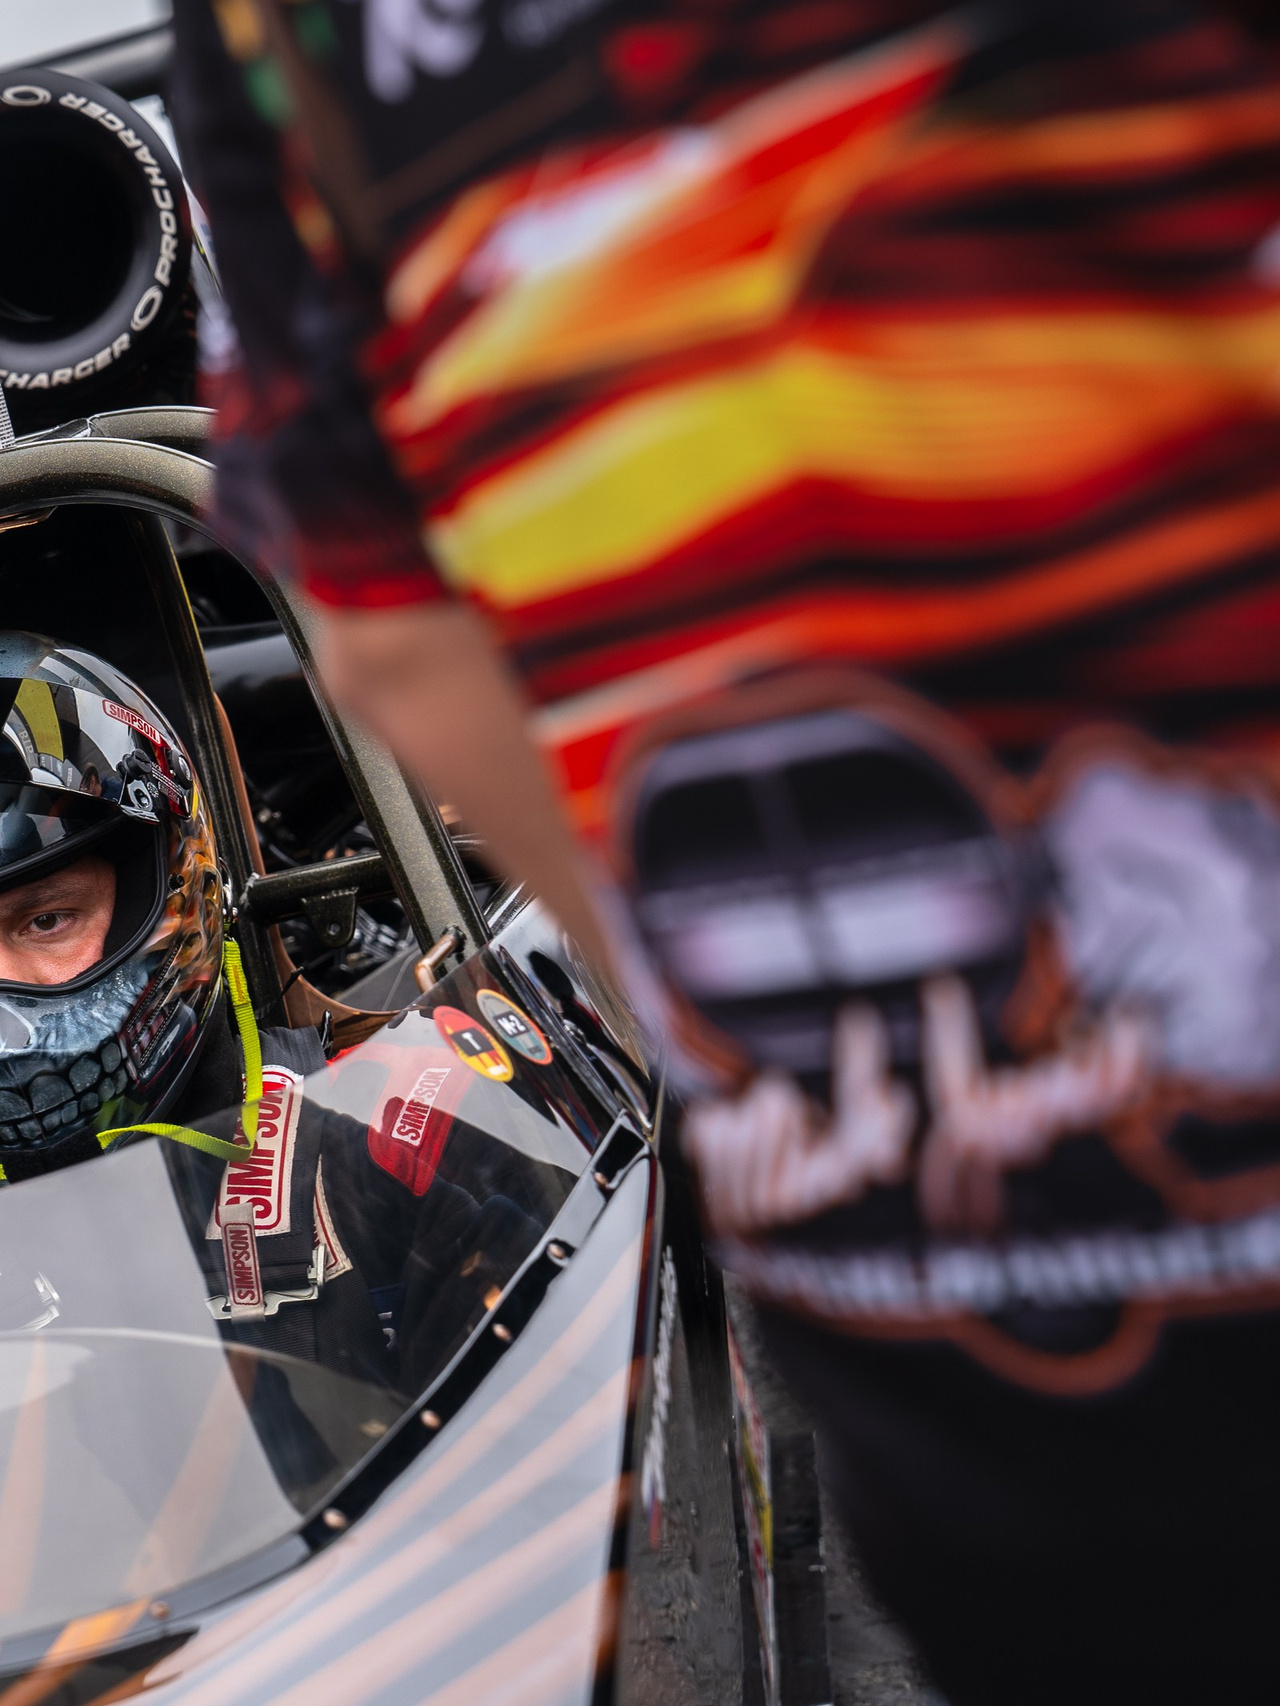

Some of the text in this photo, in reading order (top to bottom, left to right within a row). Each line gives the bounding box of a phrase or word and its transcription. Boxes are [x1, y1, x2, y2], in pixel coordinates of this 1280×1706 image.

[58, 92, 179, 287] PROCHARGER
[108, 704, 158, 743] SIMPSON
[397, 1069, 445, 1142] SIMPSON
[228, 1228, 256, 1301] SIMPSON
